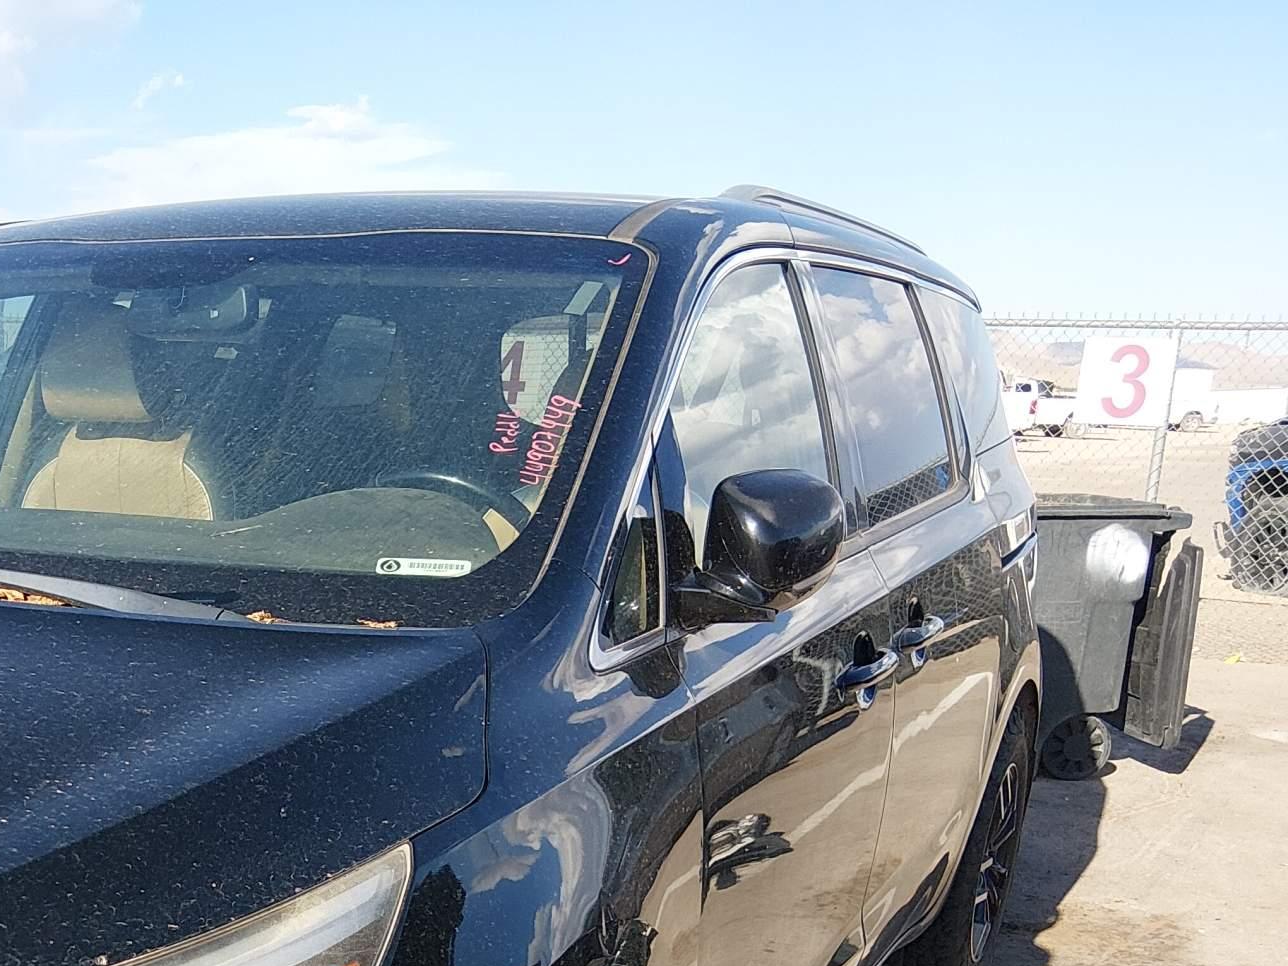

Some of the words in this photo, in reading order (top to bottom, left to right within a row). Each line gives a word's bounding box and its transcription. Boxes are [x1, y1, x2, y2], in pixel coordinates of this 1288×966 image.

[501, 340, 526, 405] 4
[1100, 344, 1150, 419] 3
[519, 395, 582, 485] 44907449
